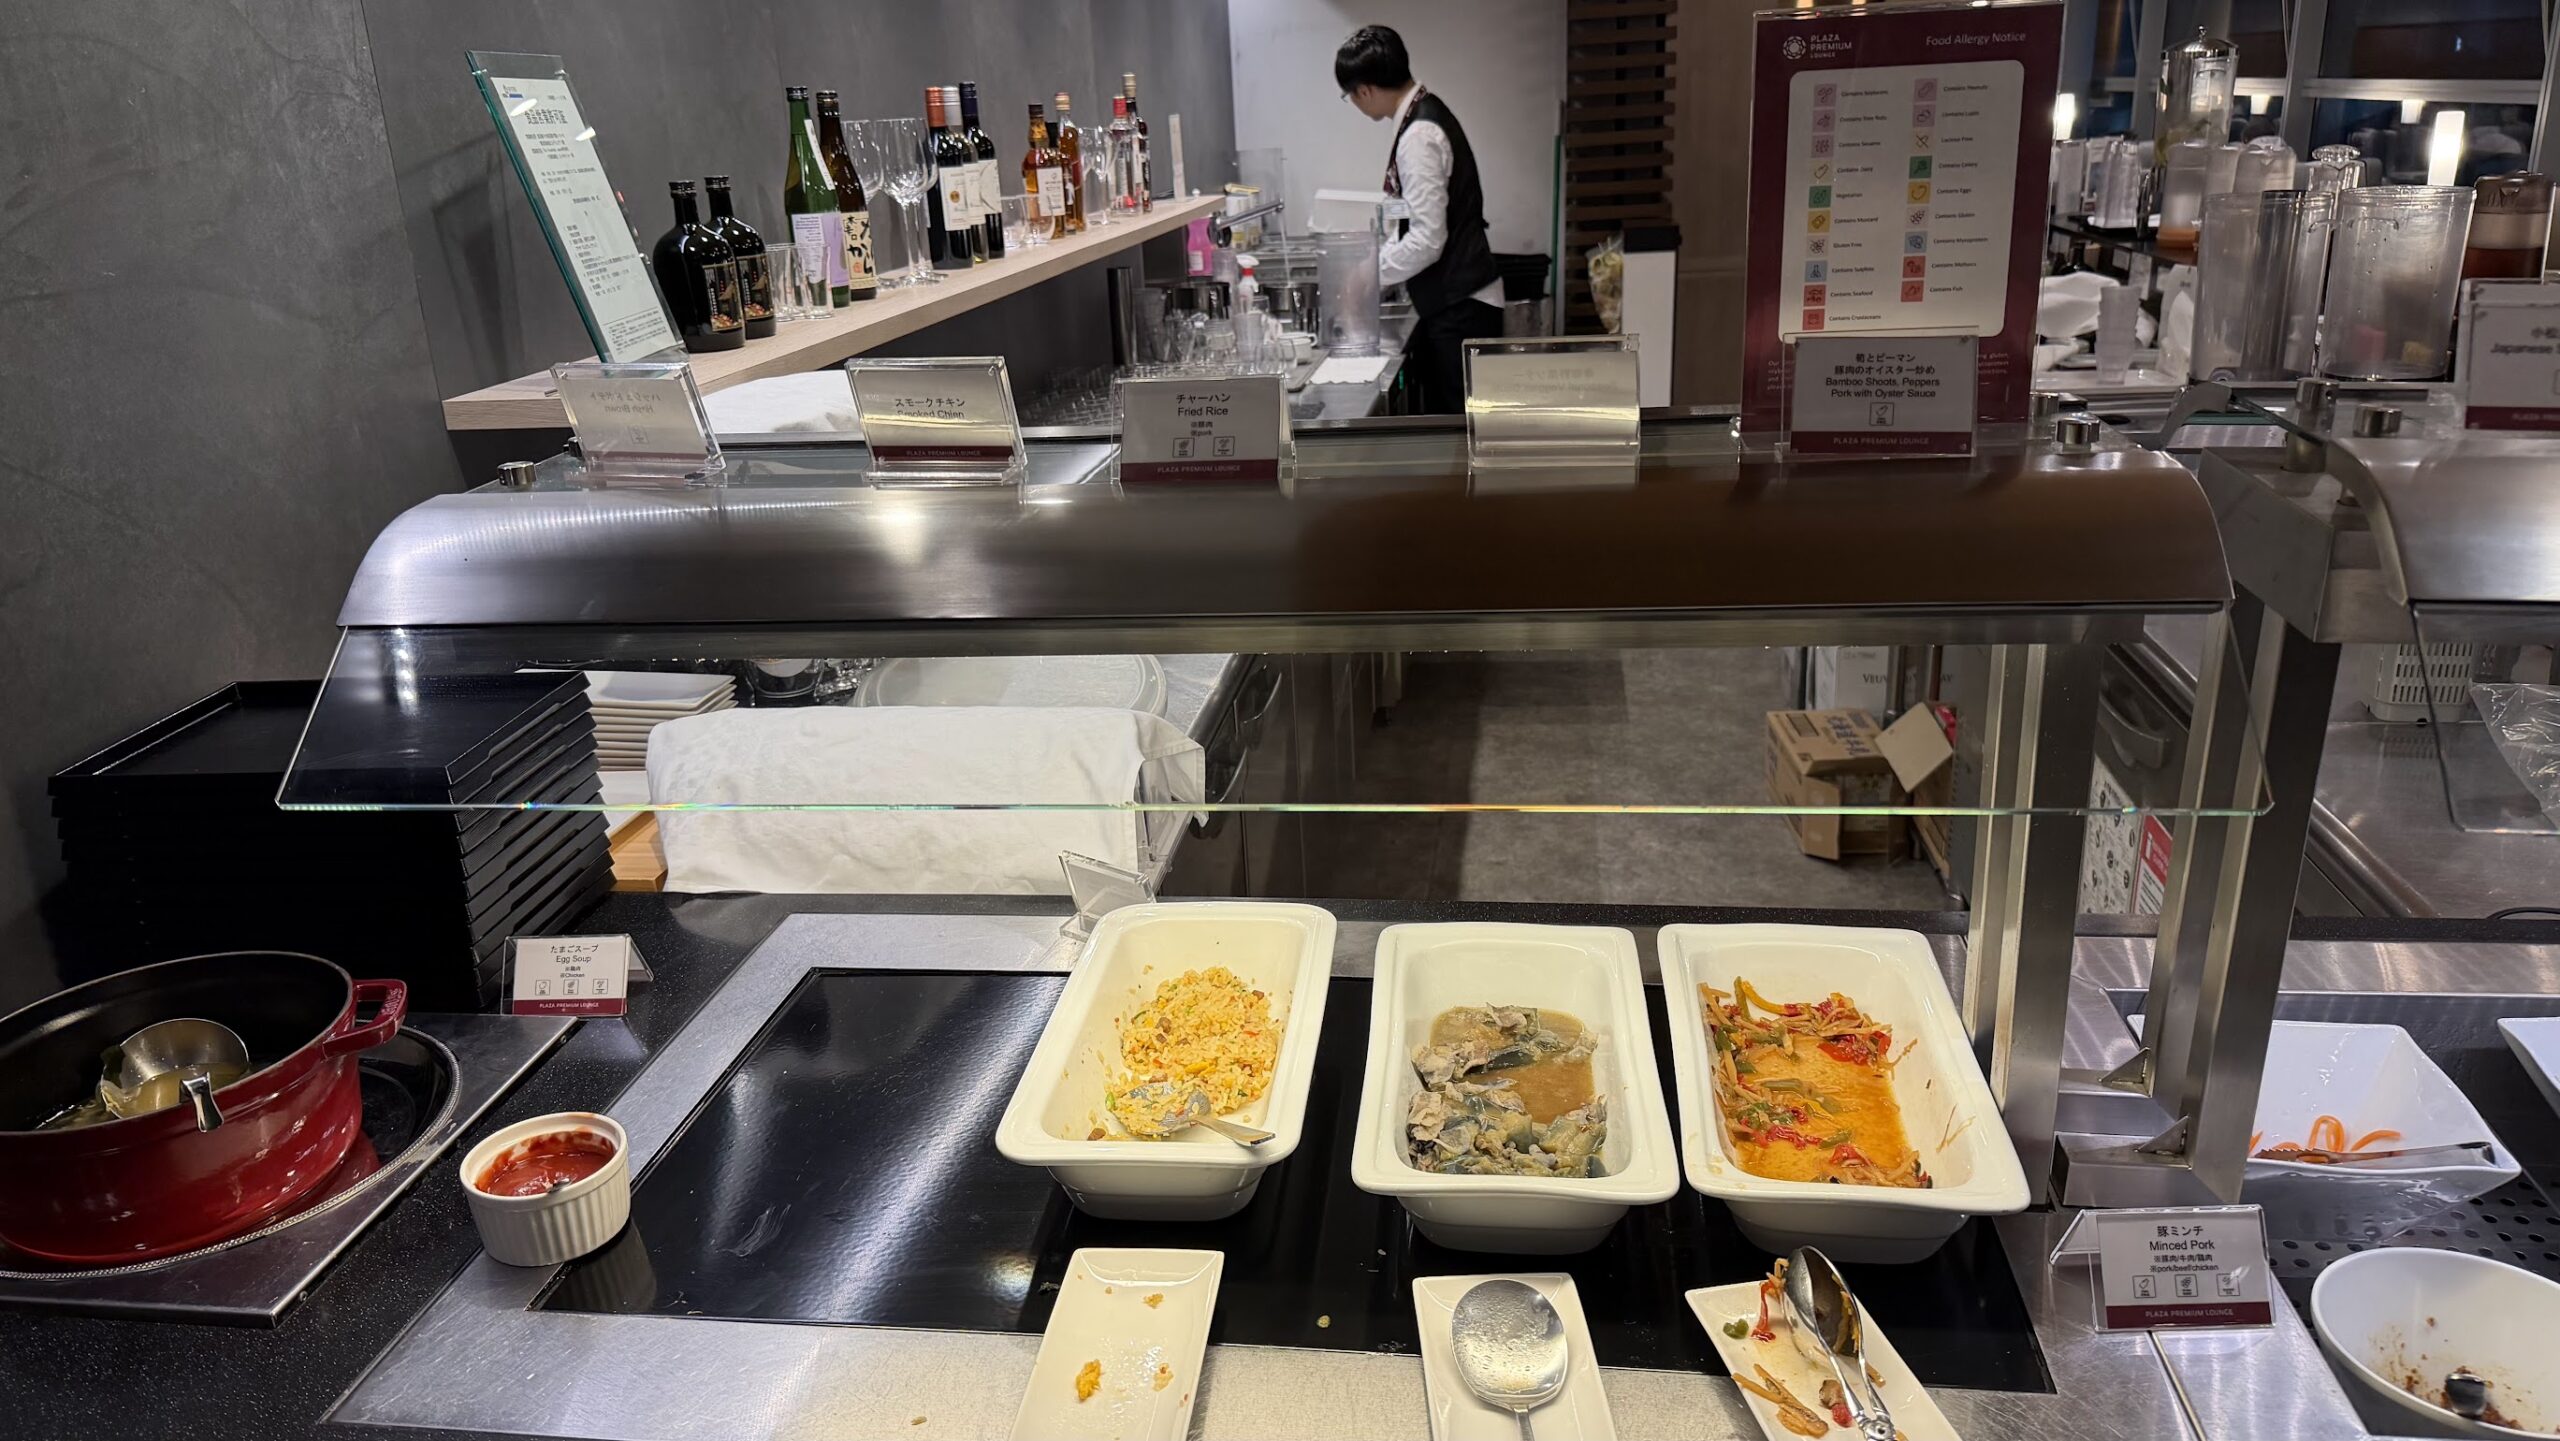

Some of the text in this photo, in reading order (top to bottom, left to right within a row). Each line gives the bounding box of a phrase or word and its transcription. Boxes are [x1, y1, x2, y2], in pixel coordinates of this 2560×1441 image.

[1810, 34, 1840, 42] PLAZA
[1926, 31, 2026, 47] Food Allergy Notice
[1810, 42, 1852, 51] PREMIUM
[1825, 377, 1863, 386] Bamboo
[1902, 377, 1940, 388] Peppers
[1176, 393, 1231, 404] チャーハン
[1831, 389, 1936, 399] Pork with Oyster Sauce
[895, 398, 965, 408] スモークチキン
[1178, 406, 1229, 416] Fried Rice
[1833, 437, 1929, 445] PLAZA PREMIUM LOUNGE
[550, 944, 599, 953] たまごスープ
[556, 955, 592, 964] Egg Soup
[2157, 1225, 2204, 1237] 豚ミンチ
[2150, 1240, 2215, 1251] Minced Pork
[2170, 1309, 2204, 1317] PREMIUM
[2205, 1308, 2234, 1316] LOUNGE
